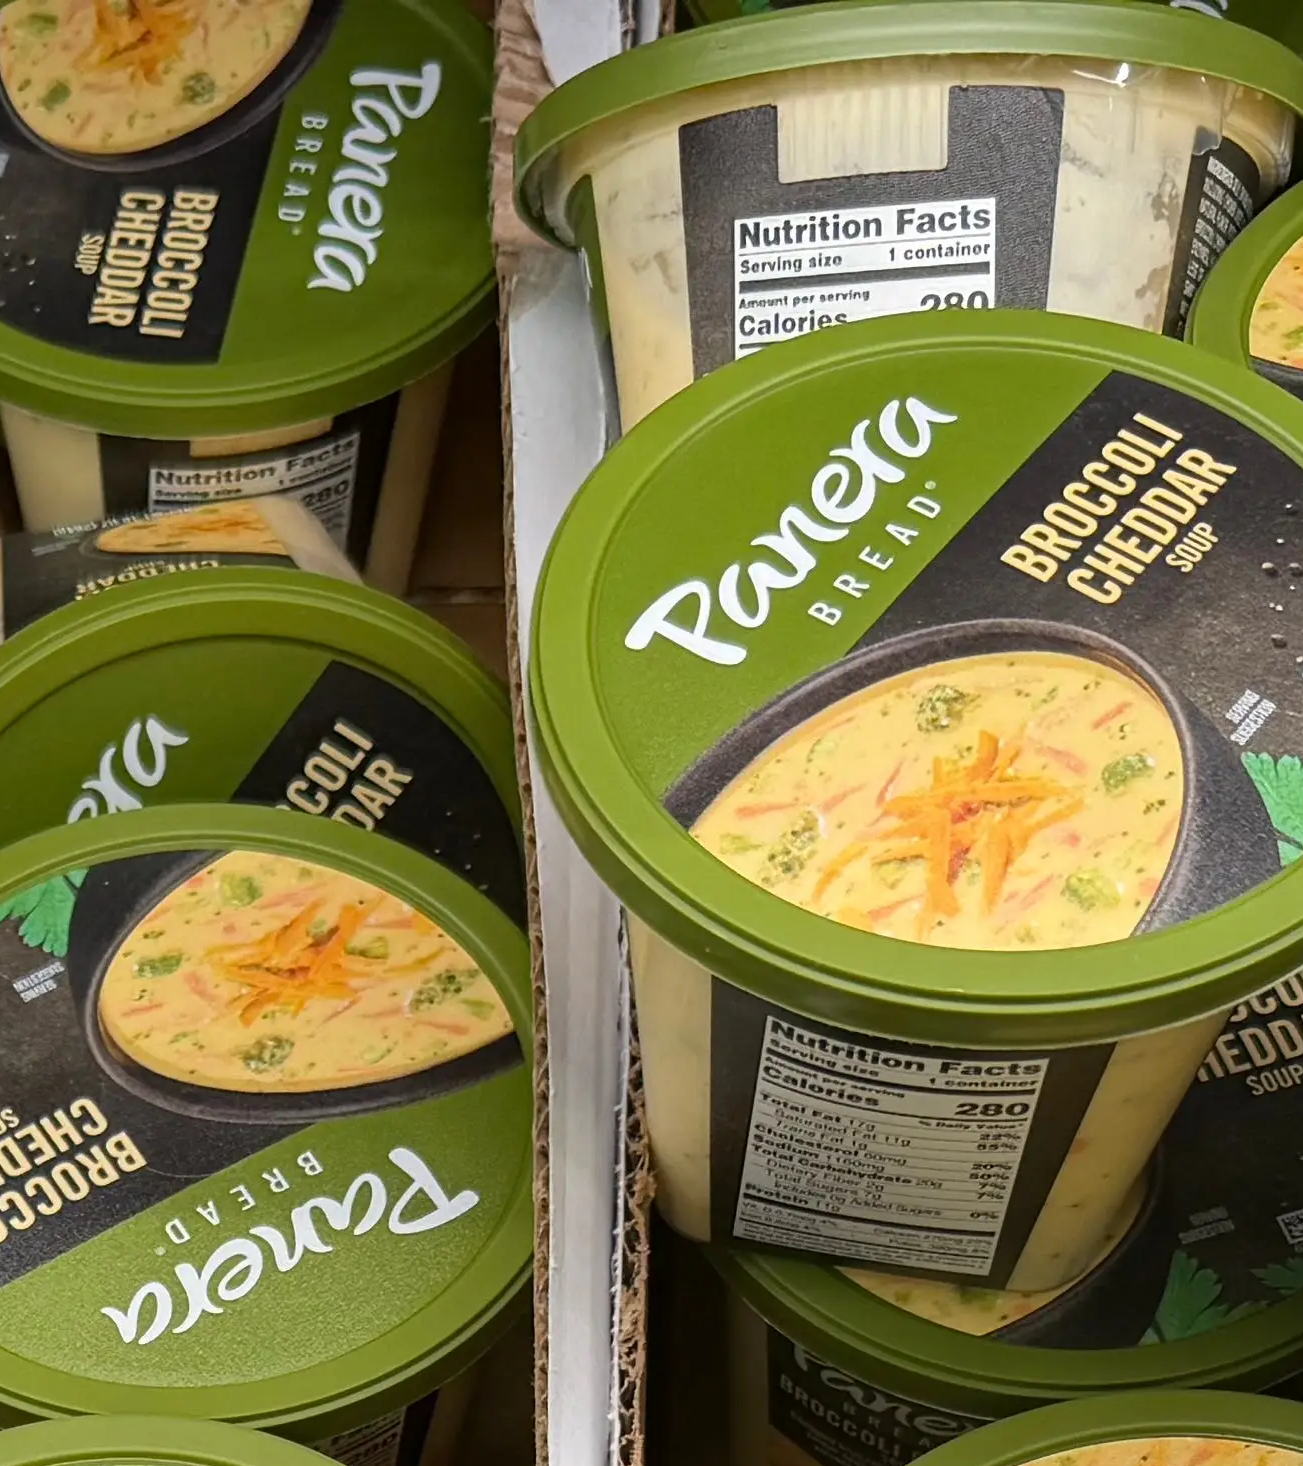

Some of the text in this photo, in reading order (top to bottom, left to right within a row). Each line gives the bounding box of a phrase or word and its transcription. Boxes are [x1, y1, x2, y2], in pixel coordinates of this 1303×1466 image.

[306, 61, 441, 293] Panera
[73, 232, 103, 276] SOUP
[739, 205, 991, 249] Nutrition Facts
[88, 189, 166, 328] CHEDDAR
[138, 186, 220, 340] BROCCOLI
[740, 242, 991, 275] Serving size 1 container
[739, 289, 870, 310] Amount per serving
[739, 310, 847, 336] Calories
[155, 465, 276, 488] Nutrition
[285, 441, 355, 473] Facts
[1001, 413, 1185, 584] BROCCOLI
[624, 396, 958, 667] Panera
[1065, 448, 1239, 606] CHEDDAR
[1164, 522, 1220, 575] SOUP
[771, 1020, 1042, 1077] Nutrition Facts
[763, 1066, 1030, 1117] Calories 280
[101, 1146, 479, 1345] Panera
